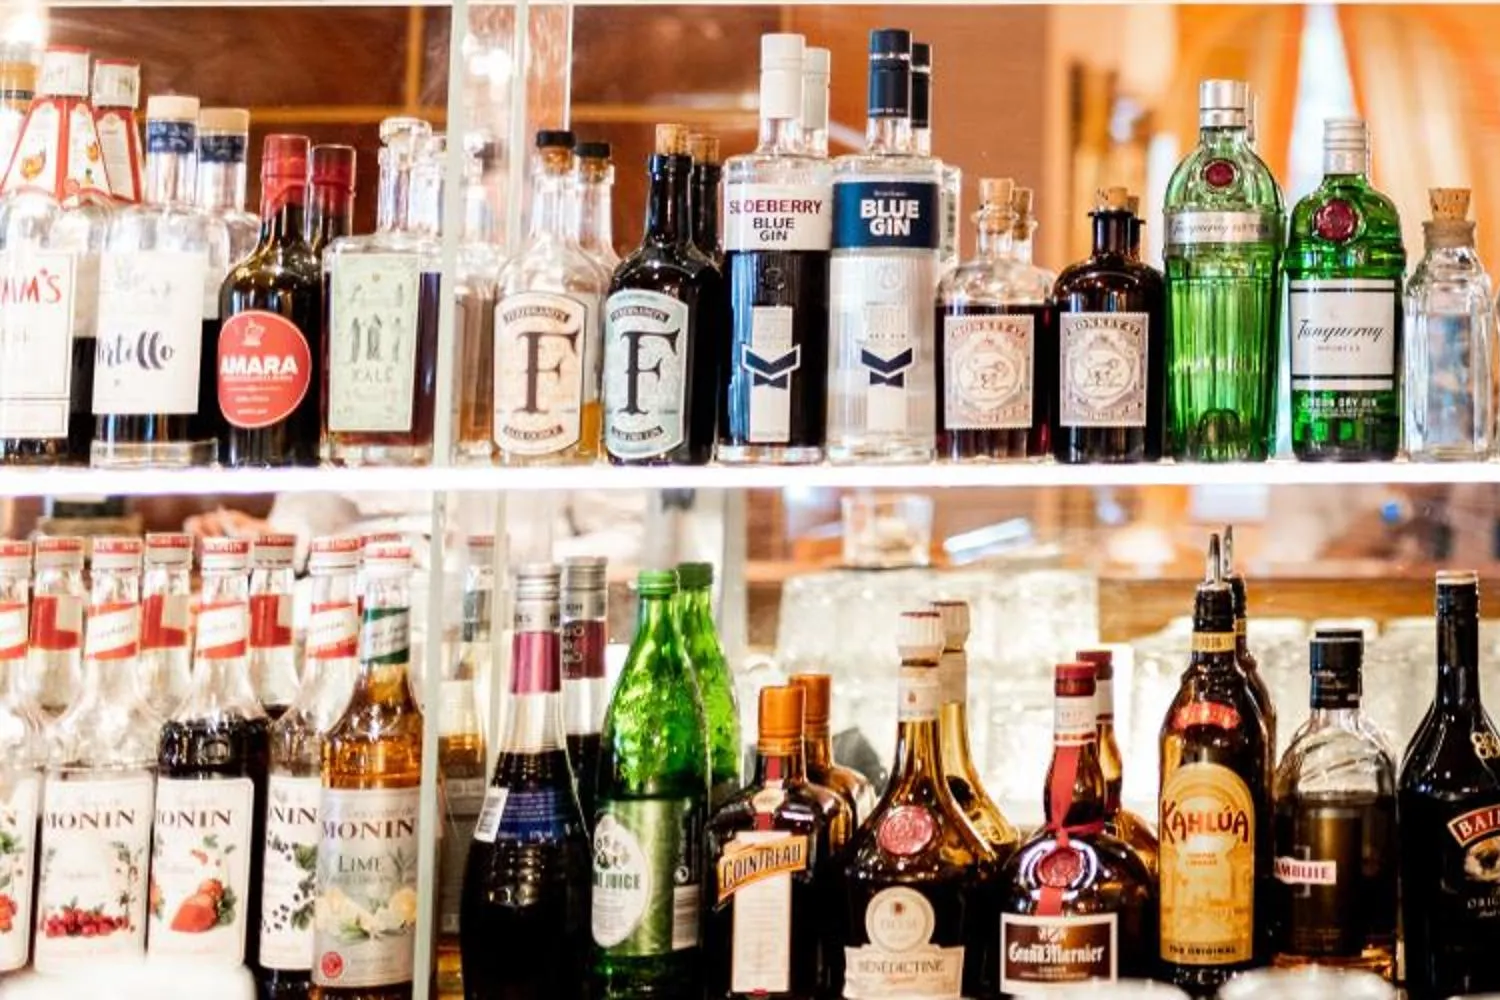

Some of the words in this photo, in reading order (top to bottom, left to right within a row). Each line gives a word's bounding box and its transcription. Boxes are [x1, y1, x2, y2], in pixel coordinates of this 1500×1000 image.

[729, 199, 823, 215] SLOEBERRY
[859, 199, 920, 219] BLUE
[753, 217, 796, 230] BLUE
[870, 219, 911, 237] GIN
[759, 230, 788, 243] GIN
[1297, 318, 1385, 343] Tanqueray
[220, 354, 299, 376] AMARA
[512, 326, 581, 416] F
[617, 326, 681, 416] F
[157, 808, 233, 829] ONIN
[269, 806, 318, 825] NIN
[1160, 798, 1250, 845] KAHLÚA
[322, 817, 415, 841] MONIN
[722, 842, 802, 890] COINTREAU
